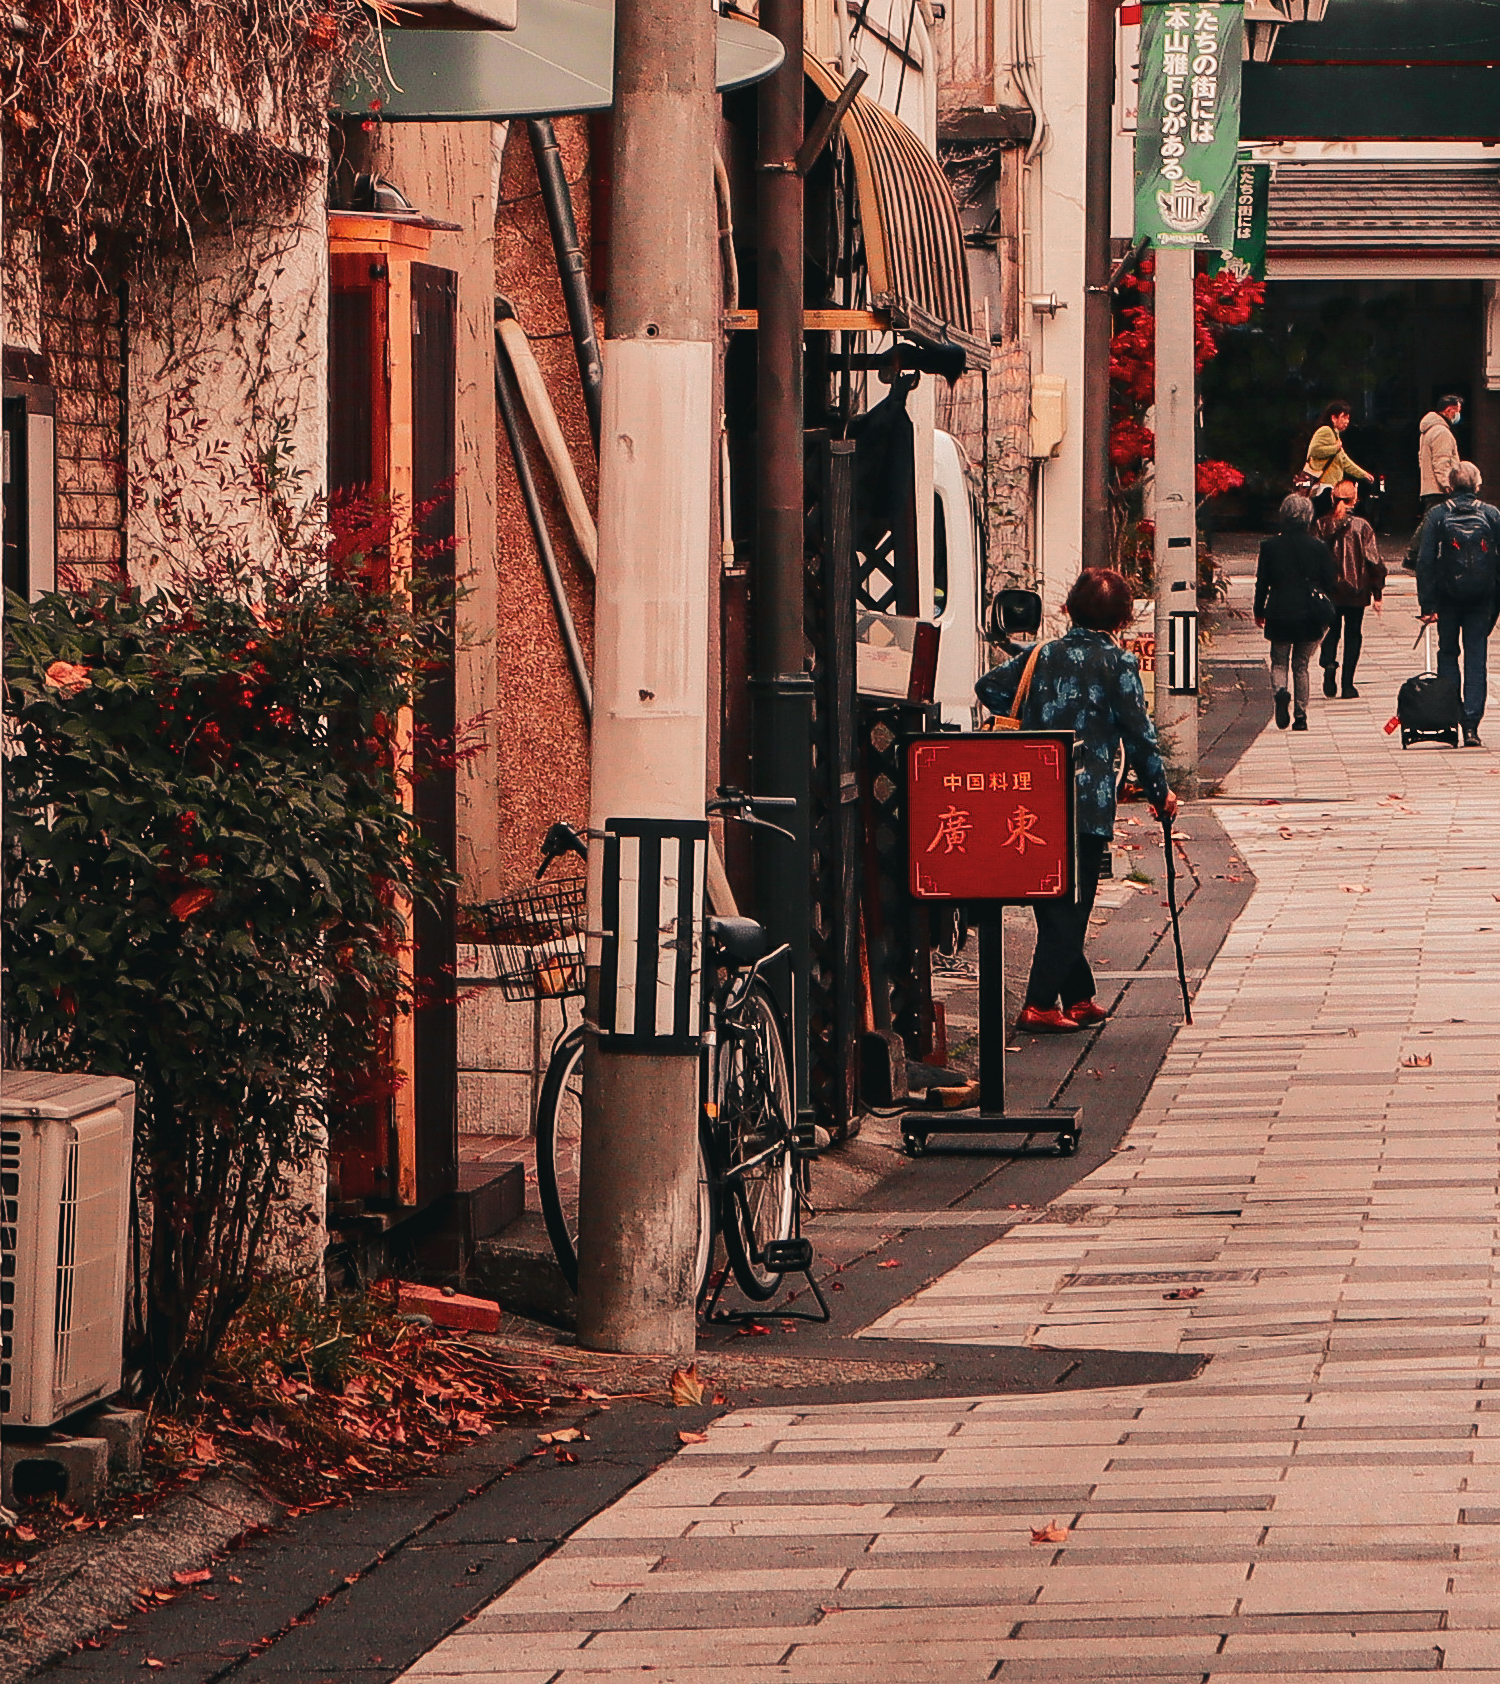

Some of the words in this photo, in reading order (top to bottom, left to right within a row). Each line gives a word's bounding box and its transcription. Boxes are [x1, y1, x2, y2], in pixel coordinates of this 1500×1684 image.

[942, 770, 1034, 793] 中国料理
[925, 804, 1048, 857] 廣東
